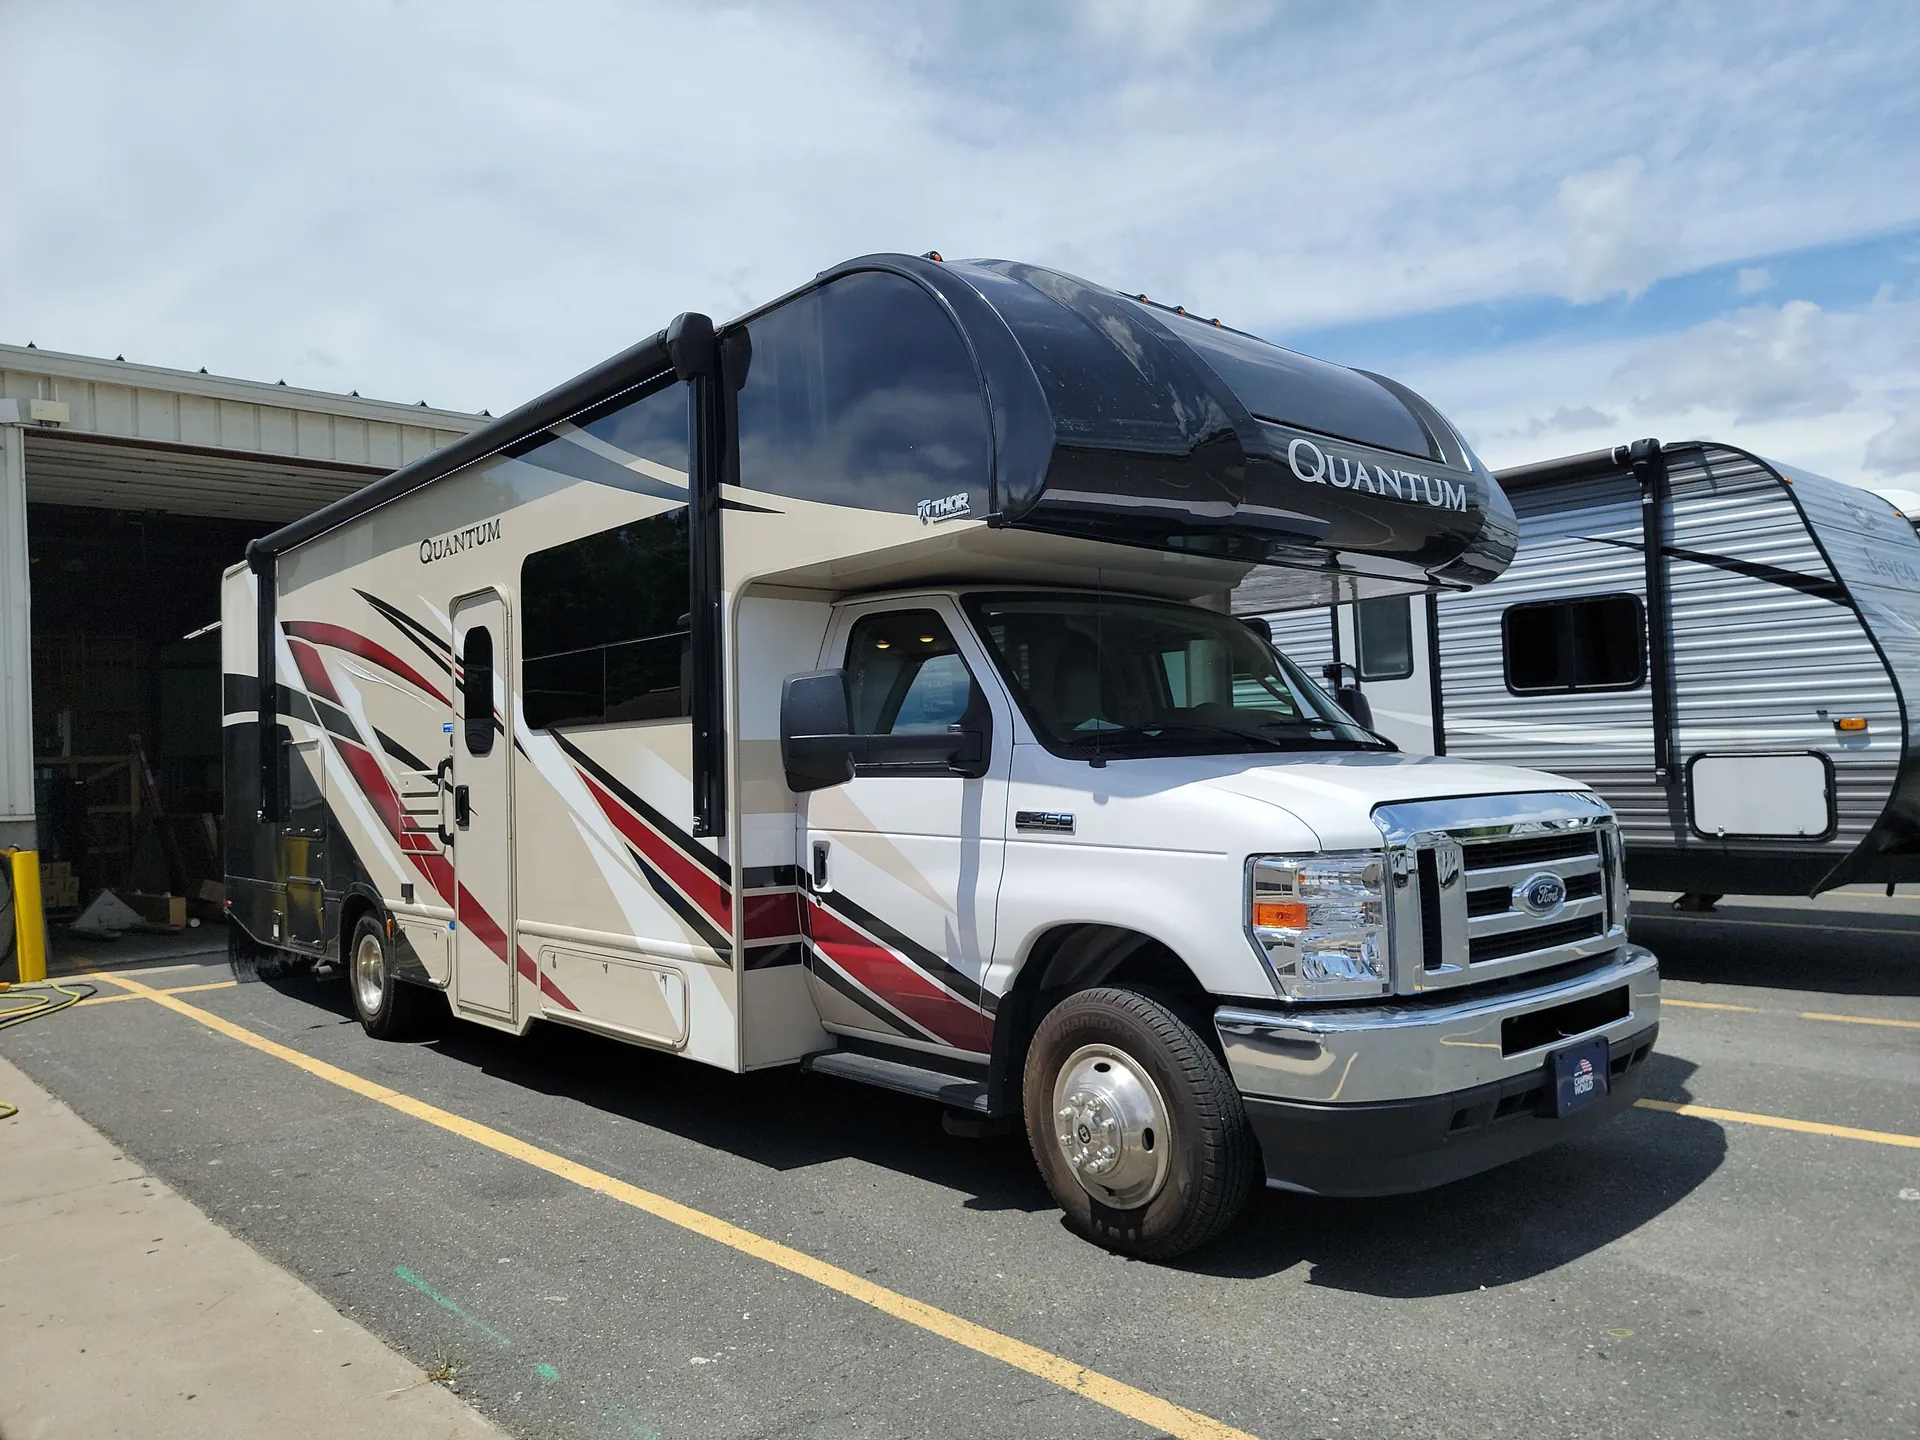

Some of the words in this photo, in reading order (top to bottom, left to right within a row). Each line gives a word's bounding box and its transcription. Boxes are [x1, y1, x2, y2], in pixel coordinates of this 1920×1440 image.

[1287, 438, 1467, 513] QUANTUM
[932, 492, 970, 516] THOR
[419, 518, 501, 564] QUANTUM
[1537, 884, 1559, 904] Ford
[1574, 1080, 1594, 1096] WORLD
